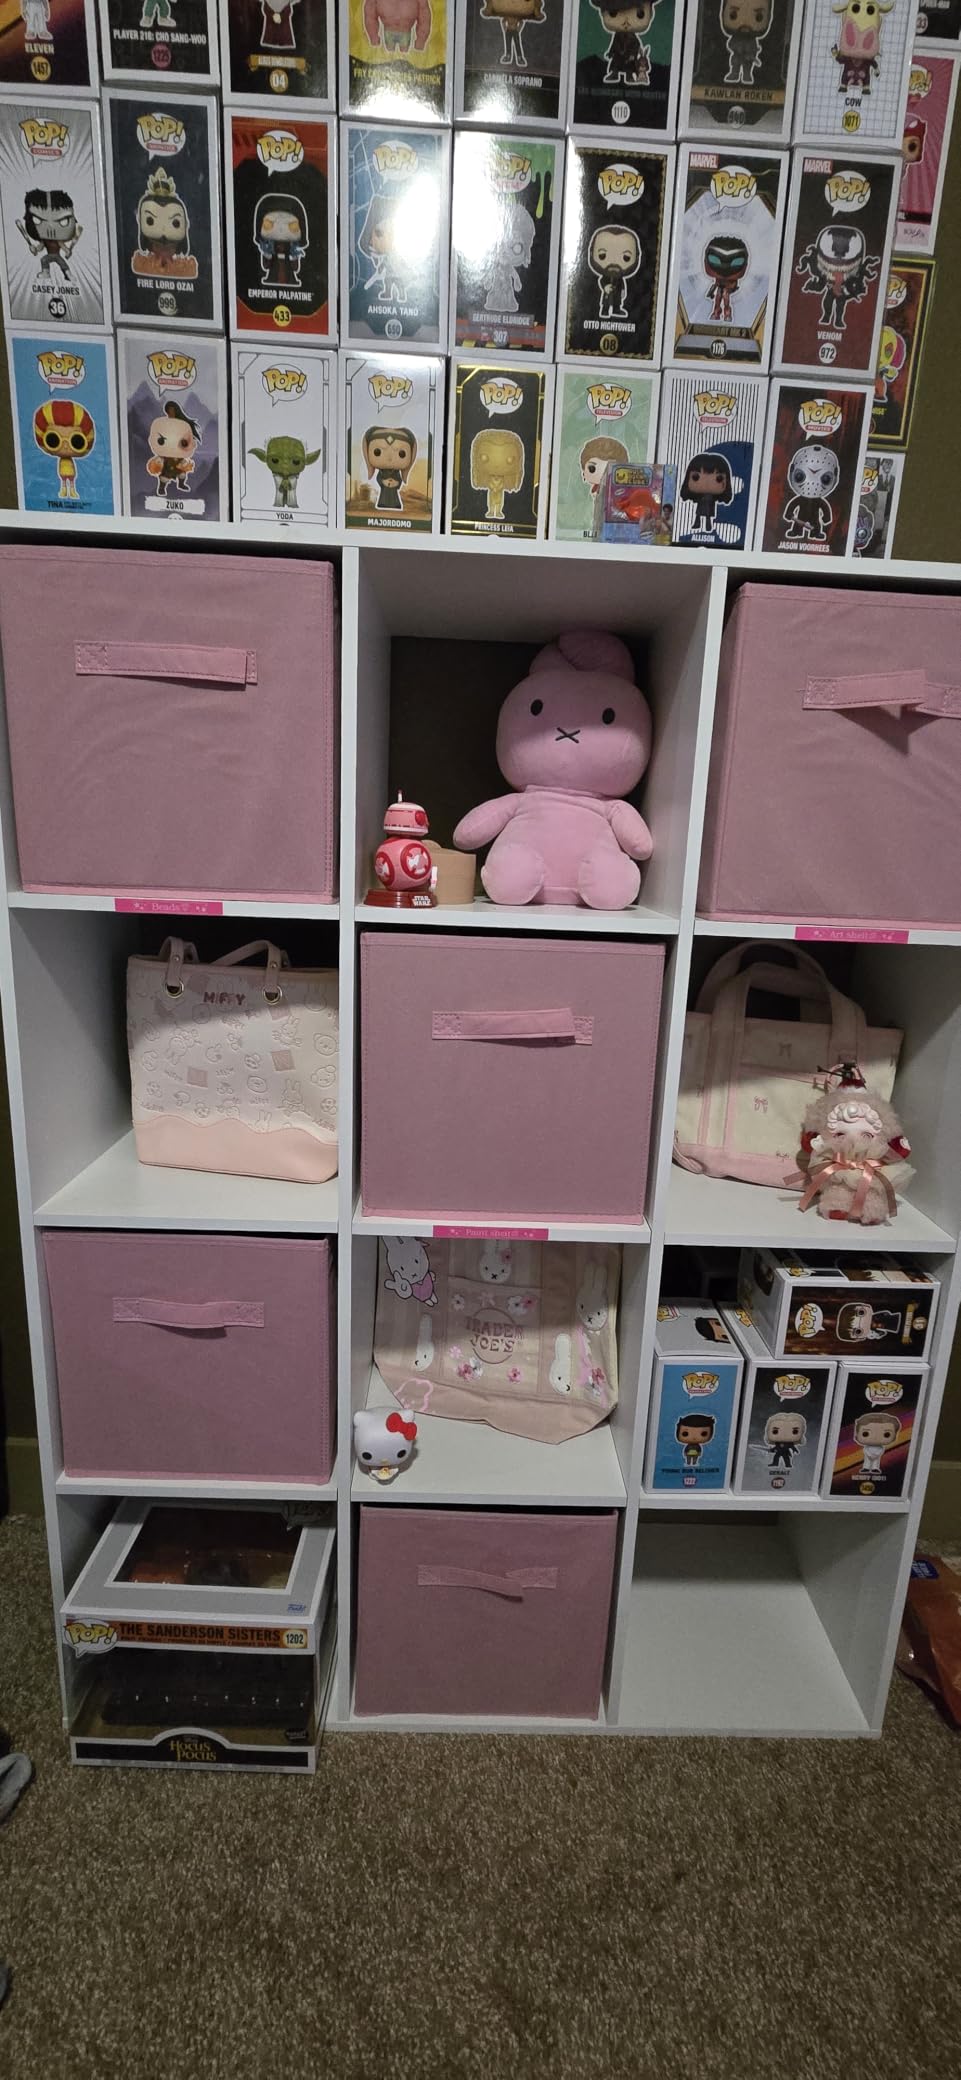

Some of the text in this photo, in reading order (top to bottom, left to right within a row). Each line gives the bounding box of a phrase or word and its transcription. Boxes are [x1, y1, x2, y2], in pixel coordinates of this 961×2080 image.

[113, 29, 139, 40] PLAYER
[155, 31, 170, 42] CHO
[25, 42, 54, 54] ELEVEN
[272, 73, 286, 89] 04
[514, 76, 543, 88] SOPRANO
[845, 97, 862, 107] COW
[19, 118, 68, 148] POP!
[136, 114, 184, 144] POP!
[257, 135, 301, 163] POP!
[374, 144, 416, 172] POP!
[690, 153, 718, 169] MARVEL
[803, 158, 832, 173] MARVEL
[600, 168, 644, 197] POP!
[712, 170, 757, 199] POP!
[827, 176, 870, 203] POP!
[32, 284, 80, 296] CASEY JONES
[137, 279, 194, 292] FIRE LORD OZAI
[248, 289, 312, 301] EMPEROR PALPATINE
[50, 301, 64, 314] 36
[368, 305, 418, 316] AHSOKA TANO
[274, 309, 290, 322] 433
[583, 320, 636, 333] OTTO HIGHTOWER
[493, 331, 508, 343] 307
[817, 331, 842, 341] VENOM
[603, 339, 616, 350] 08
[820, 347, 835, 359] 972
[37, 351, 84, 377] POP!
[146, 350, 196, 378] POP!
[262, 368, 307, 393] POP!
[368, 374, 412, 400] POP!
[480, 382, 523, 407] POP!
[587, 383, 632, 409] POP!
[693, 391, 737, 416] POP!
[800, 400, 841, 425] POP!
[47, 500, 64, 509] TINA
[165, 501, 184, 510] ZUKO
[276, 512, 294, 520] YODA
[367, 518, 412, 528] MAJORDOMO
[474, 523, 514, 533] PRINCESS LEIA
[691, 533, 715, 543] ALLISON
[778, 541, 830, 553] JASON VOORHEES
[799, 1302, 817, 1336] POP!
[465, 1316, 524, 1339] TRADER
[470, 1334, 515, 1353] JOE'S
[682, 1372, 720, 1390] POP!
[775, 1375, 811, 1392] POP!
[867, 1381, 903, 1397] POP!
[64, 1622, 115, 1645] POP!
[119, 1623, 281, 1641] THE SANDERSON SISTERS
[286, 1633, 304, 1644] 1202
[170, 1740, 211, 1752] HOCUS
[177, 1751, 217, 1762] POCUS
